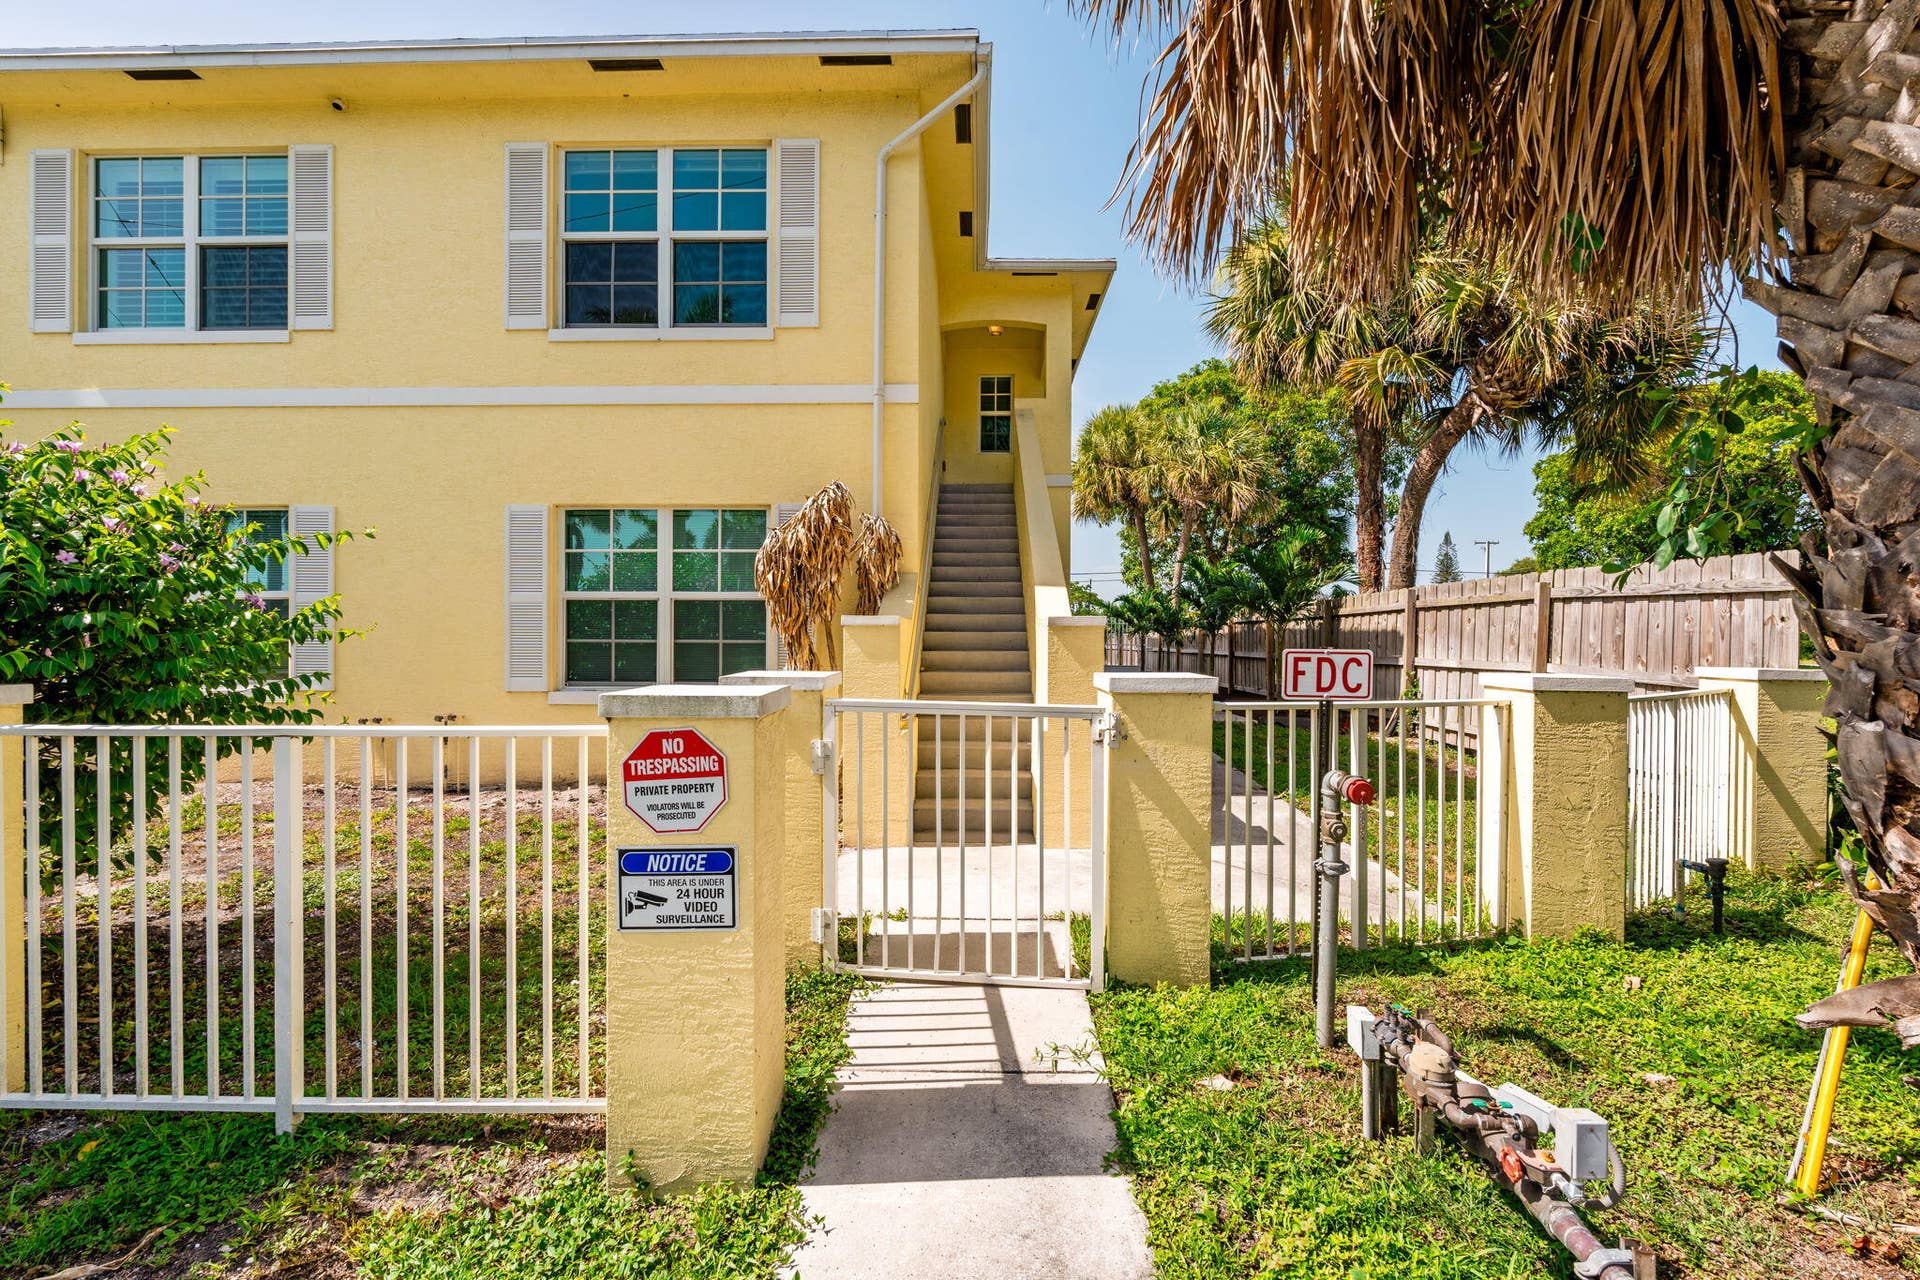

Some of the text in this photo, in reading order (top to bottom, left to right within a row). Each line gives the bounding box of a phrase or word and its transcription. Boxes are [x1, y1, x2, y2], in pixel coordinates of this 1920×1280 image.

[1292, 656, 1363, 693] FDC
[661, 738, 684, 755] NO
[628, 755, 719, 776] TRESPASSING
[634, 782, 715, 797] PRIVATE PROPERTY
[646, 801, 705, 812] VIOLATORS WILL BE
[657, 811, 696, 821] PROSECUTED
[647, 853, 707, 872] NOTICE
[648, 878, 725, 887] THIS AREA IS UNDER
[676, 888, 725, 899] 24 HOUR
[684, 901, 718, 913] VIDEO
[656, 914, 725, 924] SURVEILLANCE
